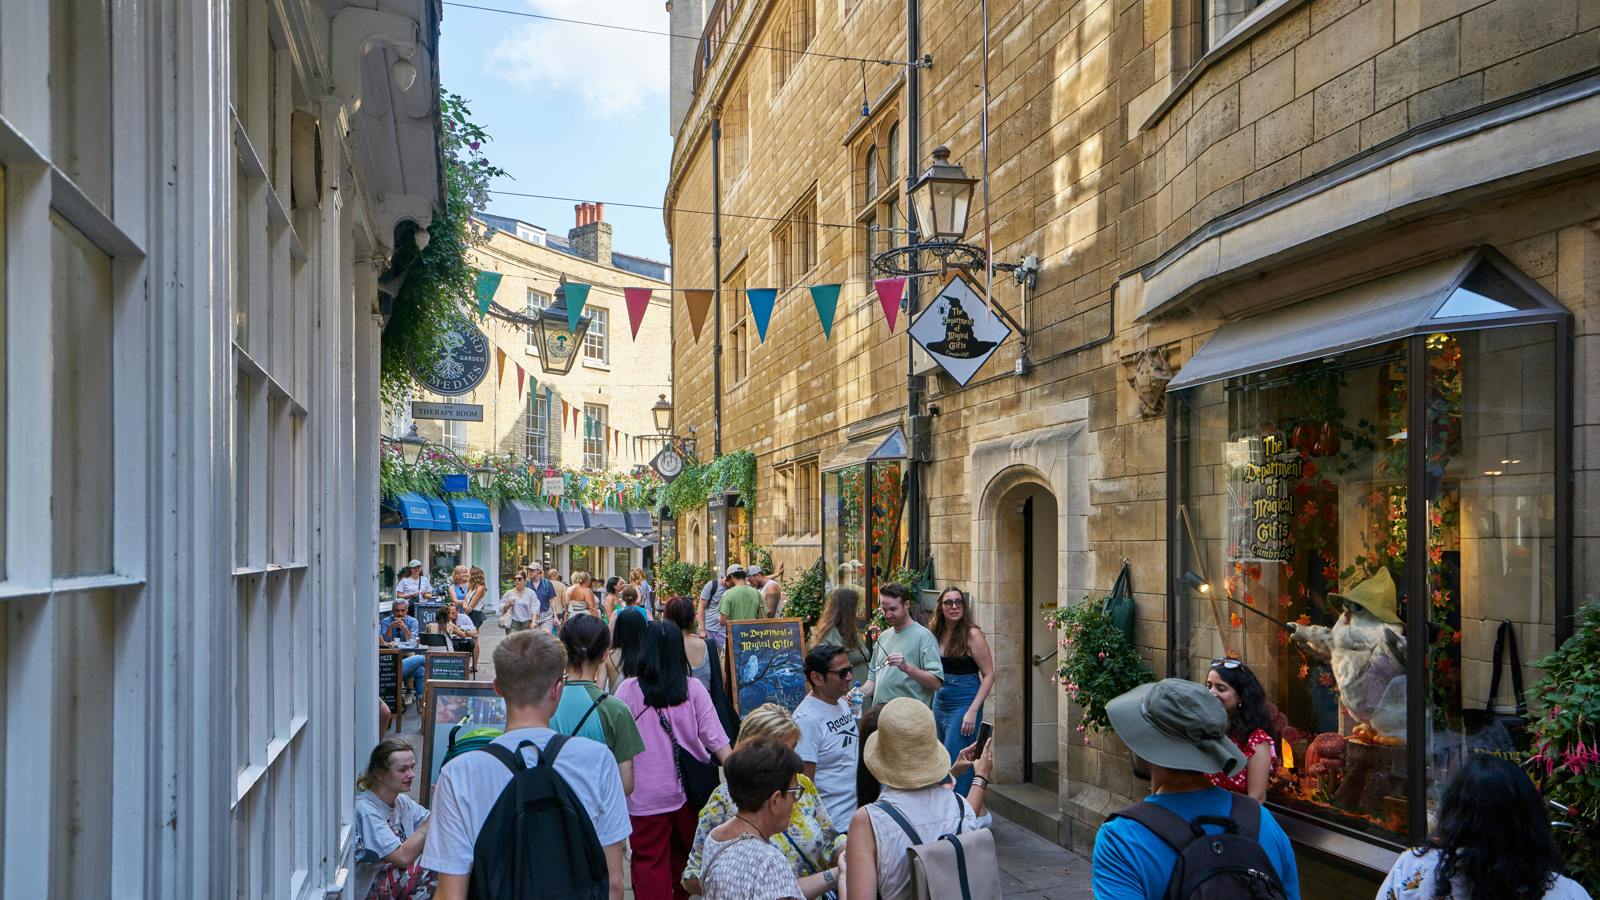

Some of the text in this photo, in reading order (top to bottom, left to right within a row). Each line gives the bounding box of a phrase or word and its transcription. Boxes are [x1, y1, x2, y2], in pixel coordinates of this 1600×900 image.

[952, 307, 962, 316] The
[419, 407, 478, 418] THERAPY ROOM
[1263, 435, 1284, 456] The
[1245, 459, 1303, 484] Department
[1266, 478, 1279, 497] of
[1253, 496, 1294, 520] Magical
[1256, 521, 1289, 544] Gifts
[1251, 543, 1295, 560] Cambridge
[749, 628, 787, 639] Department
[787, 629, 793, 637] of
[741, 640, 794, 652] Magical Gifts
[826, 713, 852, 733] Reebo
